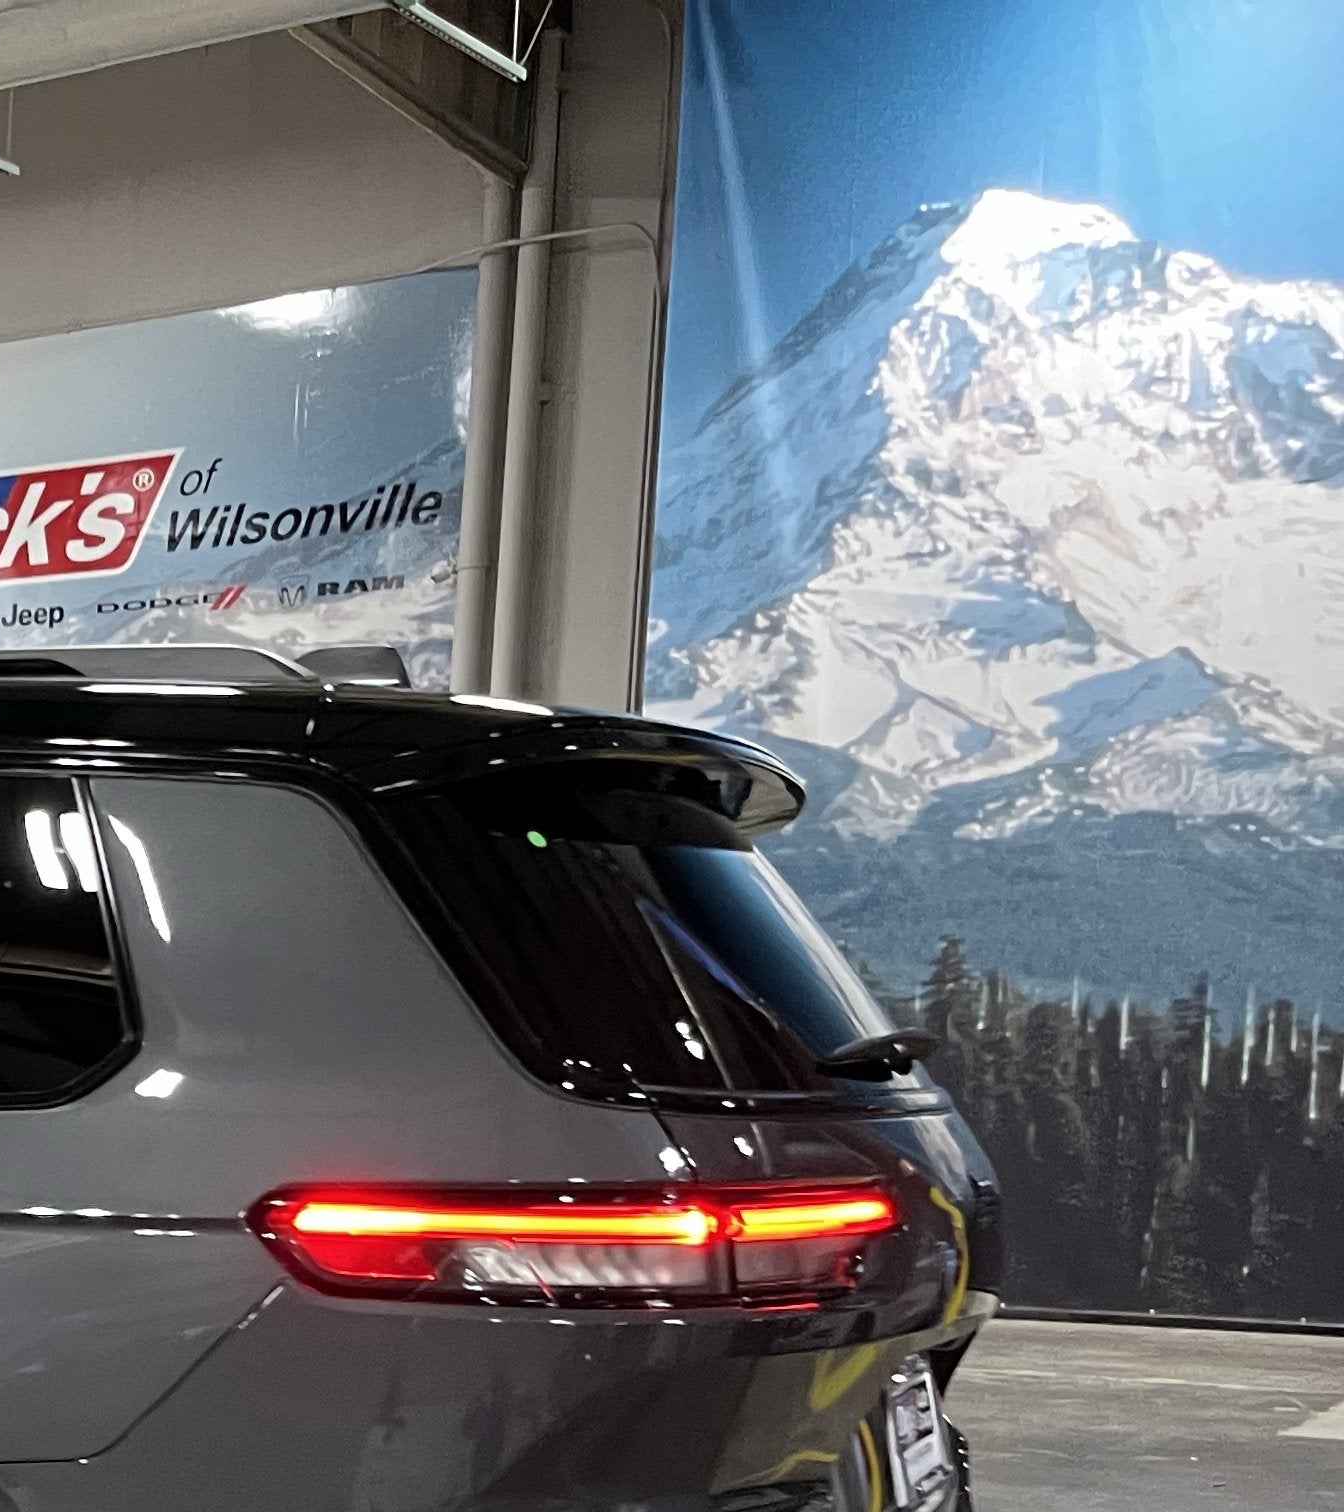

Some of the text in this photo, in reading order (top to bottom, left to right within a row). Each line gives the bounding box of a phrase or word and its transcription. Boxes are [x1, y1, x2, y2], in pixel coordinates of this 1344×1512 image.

[179, 457, 223, 496] of
[166, 482, 444, 553] Wilsonville
[1, 603, 65, 628] Jeep
[317, 574, 405, 597] RAM
